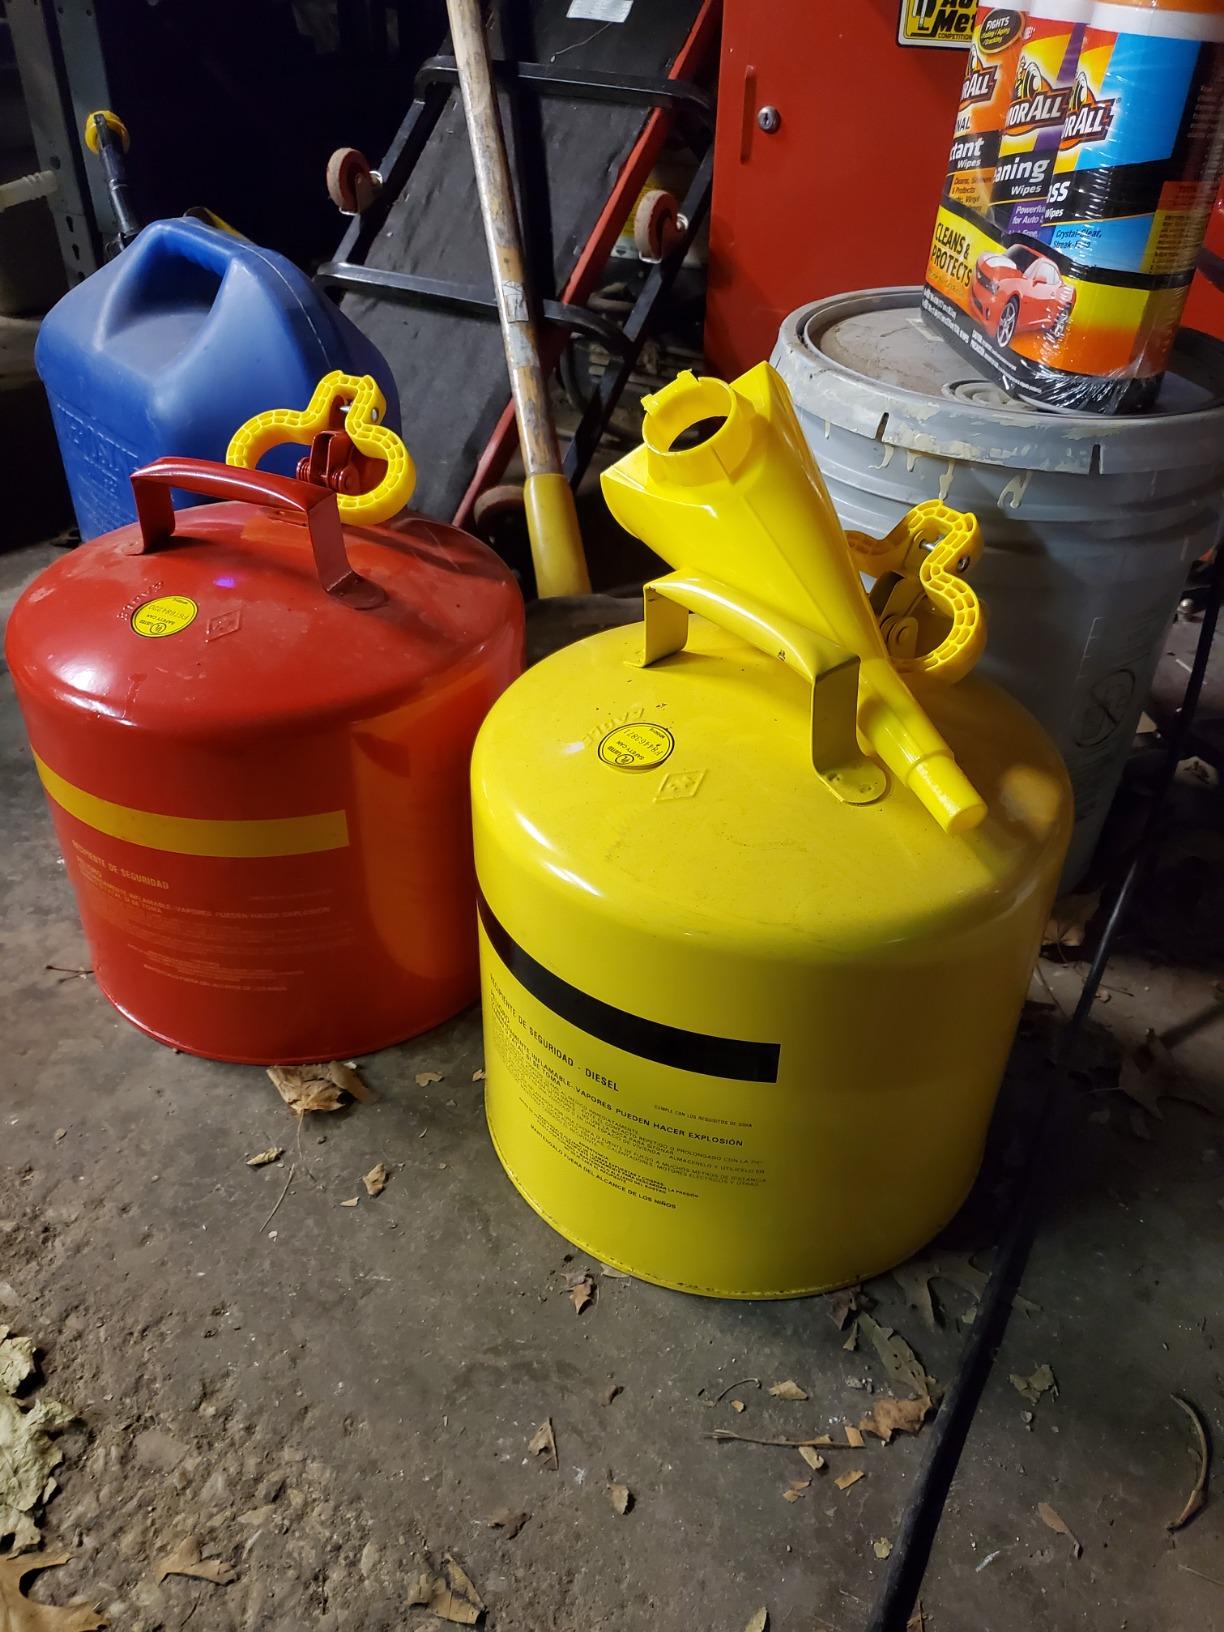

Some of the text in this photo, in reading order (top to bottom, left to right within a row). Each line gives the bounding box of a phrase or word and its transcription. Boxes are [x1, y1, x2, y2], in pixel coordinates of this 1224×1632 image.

[985, 16, 1010, 31] FIGHTS
[957, 158, 982, 169] Wipes
[1011, 184, 1042, 197] Wipes
[1012, 215, 1022, 225] for
[1022, 215, 1040, 225] Auto
[935, 222, 971, 260] CLEANS &
[931, 244, 973, 288] PROTECTS
[518, 1015, 527, 1029] DE
[529, 1026, 574, 1067] SEGURIDAD
[585, 1068, 620, 1092] DIESEL
[575, 1086, 613, 1111] VAPORES
[615, 1107, 650, 1126] PUEDEN
[653, 1121, 685, 1136] HACER
[596, 1174, 626, 1191] ALCANCE
[627, 1189, 637, 1197] DE
[639, 1193, 652, 1202] LOS
